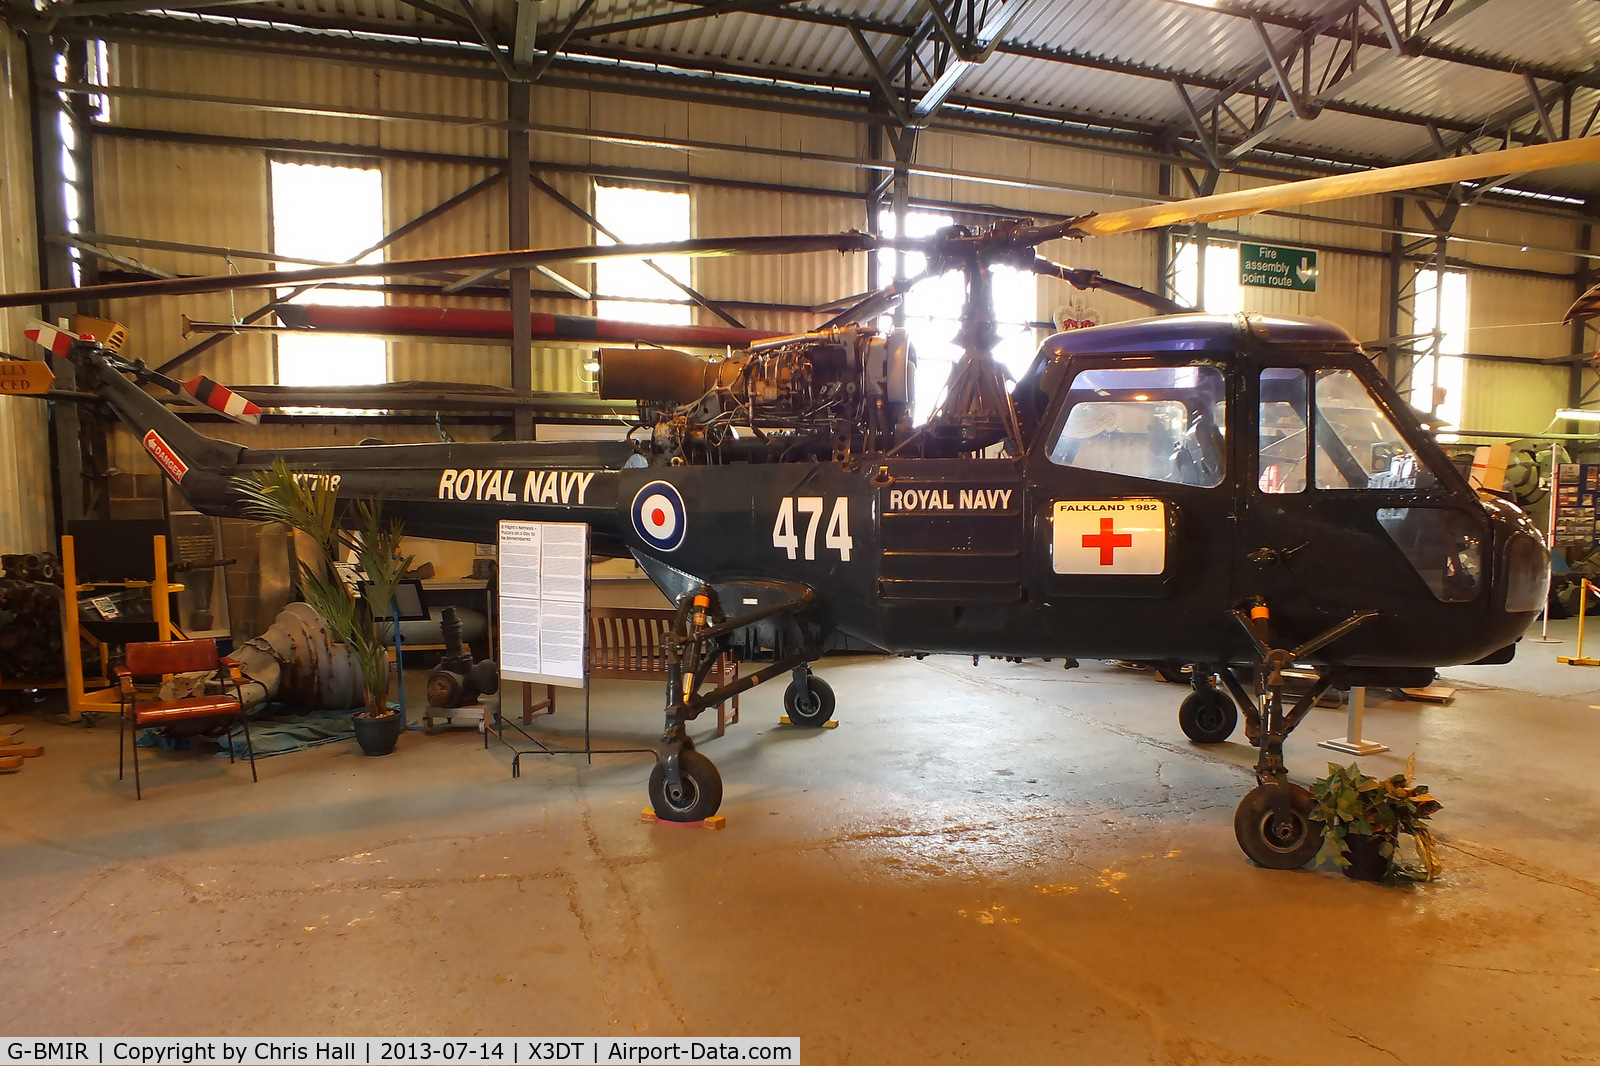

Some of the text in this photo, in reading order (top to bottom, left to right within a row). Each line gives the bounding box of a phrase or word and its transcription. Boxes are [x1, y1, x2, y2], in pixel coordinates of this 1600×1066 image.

[1259, 246, 1277, 259] Fire
[1245, 260, 1290, 275] assembly
[1242, 272, 1293, 287] point route
[0, 364, 27, 376] LLY
[154, 445, 183, 479] DANGER
[438, 468, 595, 505] ROYAL NAVY
[890, 489, 1013, 510] ROYAL NAVY
[1060, 504, 1126, 512] FALKLAND
[772, 496, 854, 562] 474
